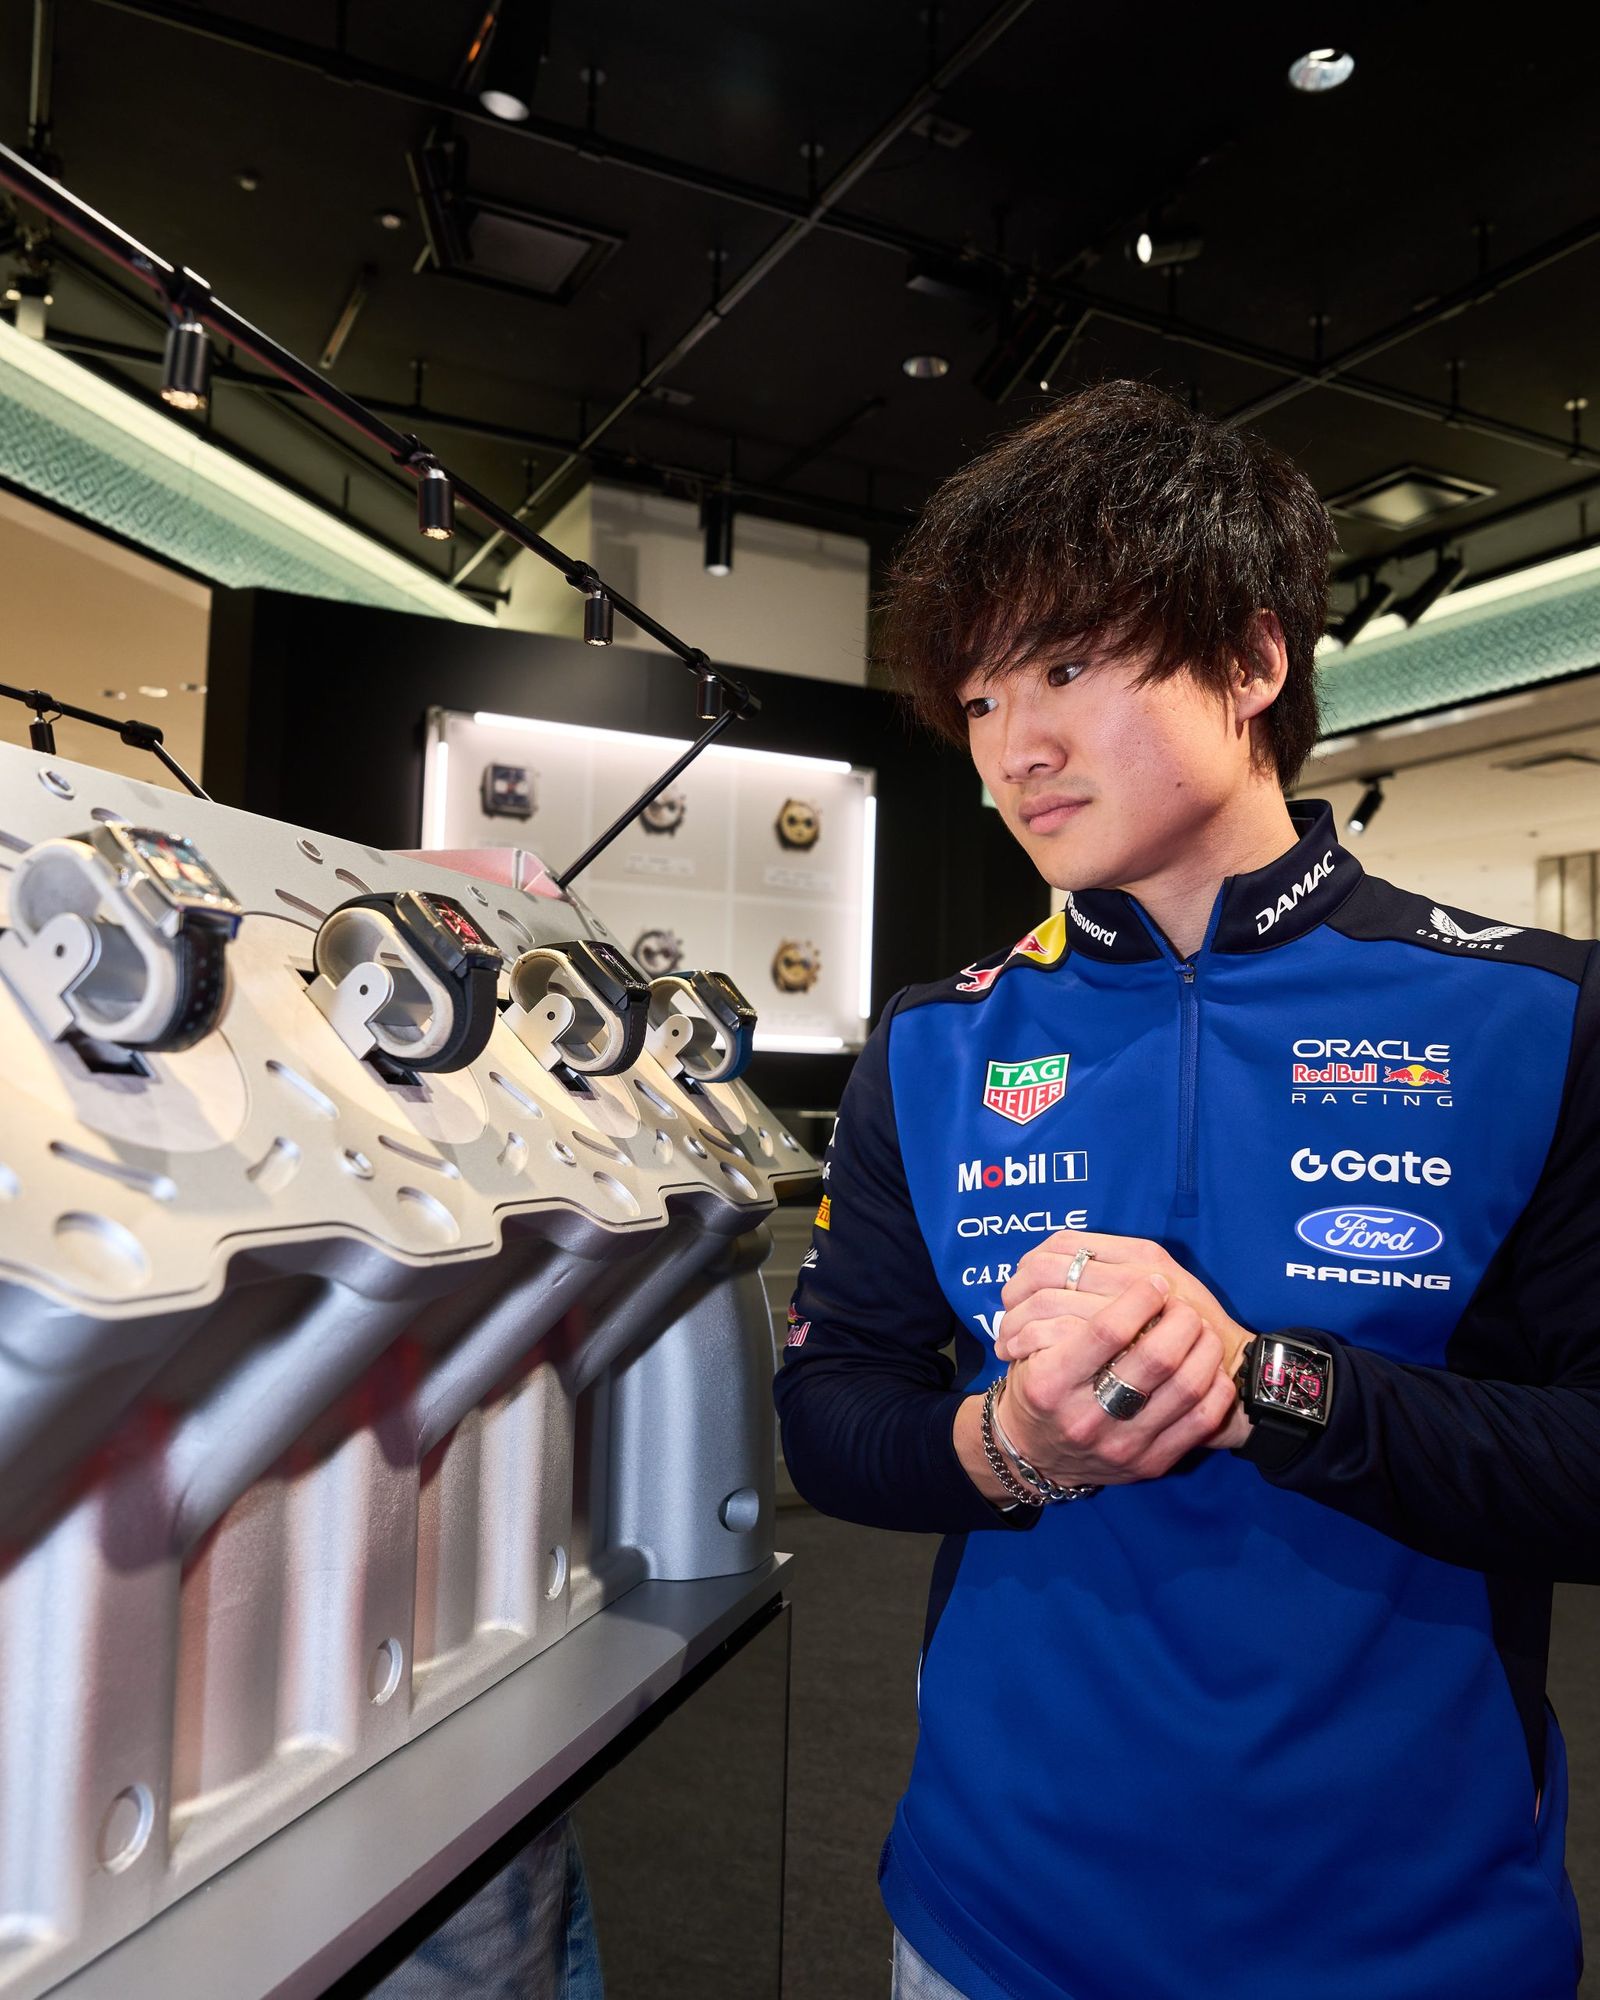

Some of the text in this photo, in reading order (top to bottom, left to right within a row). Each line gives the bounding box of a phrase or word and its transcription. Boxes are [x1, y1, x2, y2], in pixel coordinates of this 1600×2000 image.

[1255, 849, 1335, 935] DAMAC
[1415, 927, 1505, 951] CASTORE
[1292, 1039, 1451, 1063] ORACLE
[995, 1060, 1061, 1086] TAG
[989, 1083, 1061, 1119] HEUER
[1291, 1092, 1453, 1107] RACING
[957, 1153, 1047, 1193] Mobil
[1330, 1149, 1452, 1187] Gate
[956, 1209, 1089, 1238] ORACLE
[1325, 1213, 1417, 1252] Ford
[962, 1263, 1020, 1287] CAR
[1285, 1262, 1451, 1291] RACING
